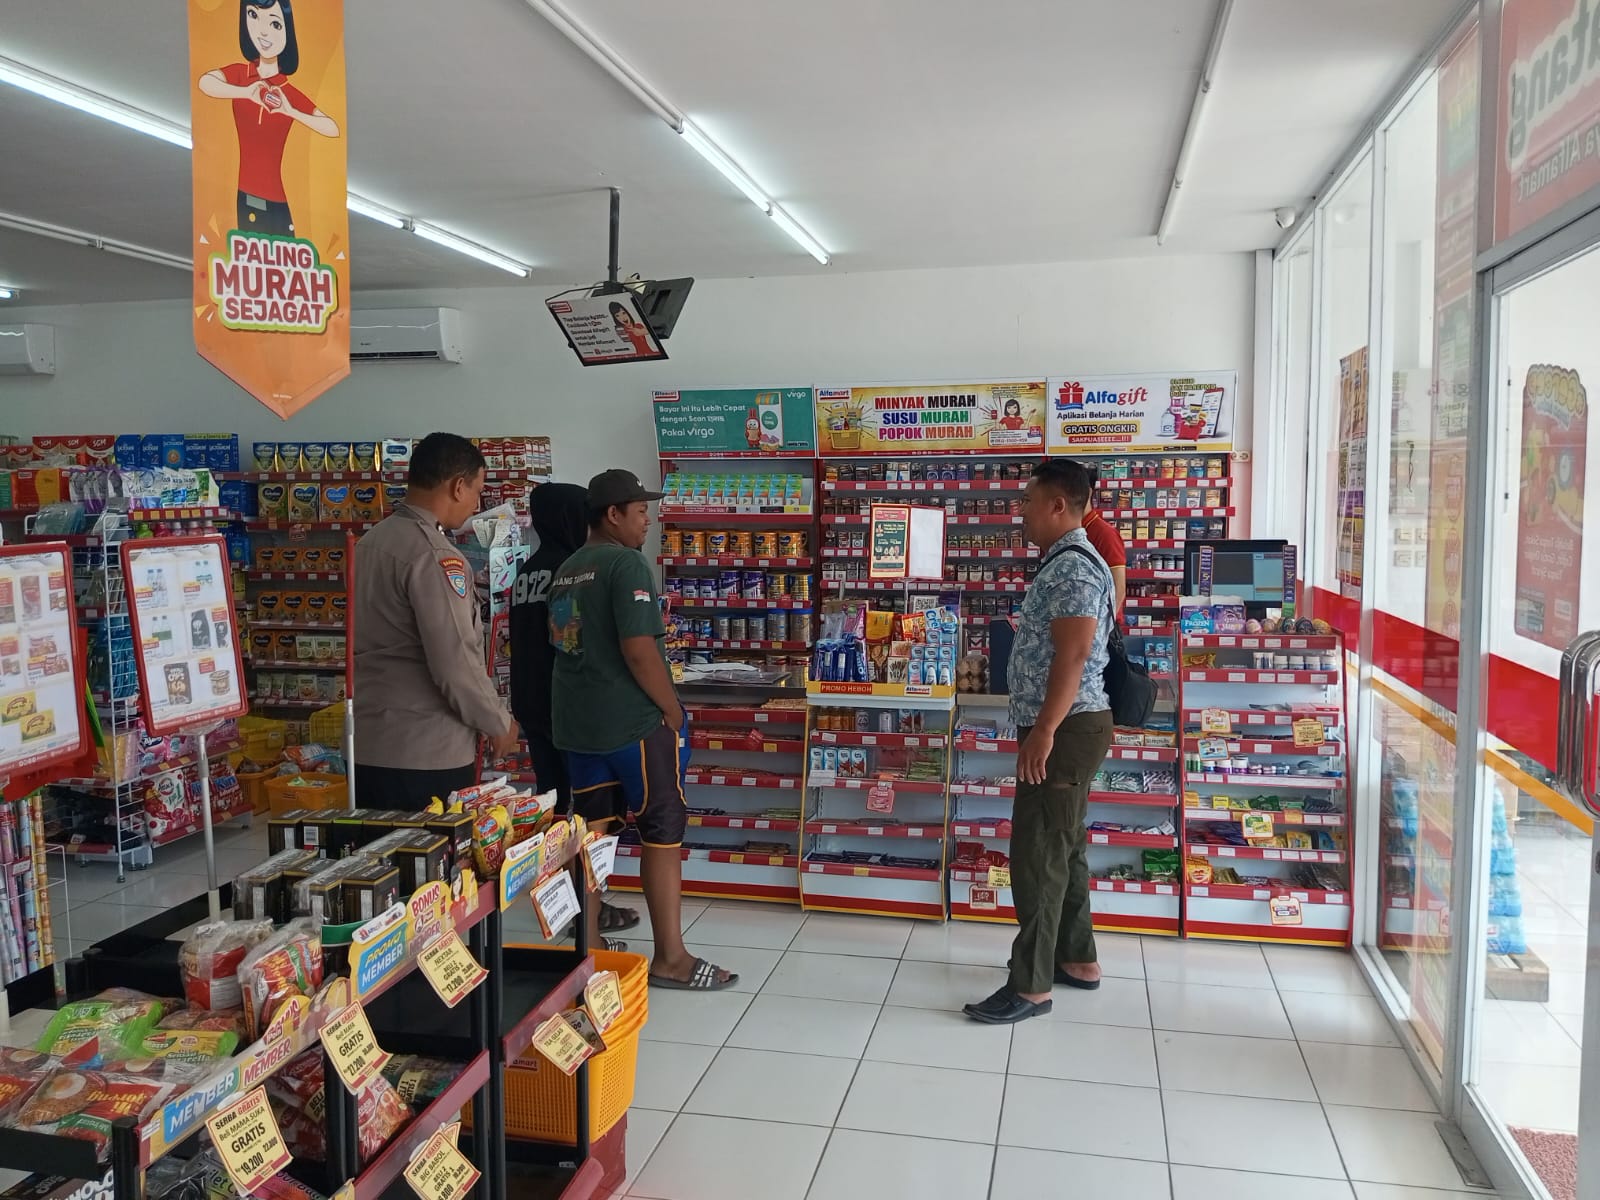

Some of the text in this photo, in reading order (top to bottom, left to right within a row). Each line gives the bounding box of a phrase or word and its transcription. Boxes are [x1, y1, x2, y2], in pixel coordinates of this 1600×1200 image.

[233, 239, 312, 269] PALING
[215, 262, 331, 303] MURAH
[225, 298, 324, 325] SEJAGAT
[702, 404, 721, 412] Lebih
[723, 404, 746, 413] Cepat
[874, 394, 976, 410] MINYAK MURAH
[1085, 387, 1148, 405] Alfagift
[660, 416, 687, 424] dengan
[882, 410, 969, 425] SUSU MURAH
[1057, 410, 1145, 420] Aplikasi Belanja Harian
[661, 428, 686, 437] Pakai
[879, 425, 973, 440] POPOK MURAH
[1064, 424, 1137, 434] GRATIS ONGKIR
[412, 884, 440, 917] BONUS
[365, 931, 402, 968] PROMO
[362, 943, 403, 987] MEMBER
[339, 1030, 364, 1056] GRATIS
[243, 1037, 292, 1088] MEMBER
[170, 1071, 235, 1133] MEMBER
[215, 1111, 237, 1130] SERBA
[219, 1106, 265, 1141] Beli MAMA SUKA
[231, 1122, 266, 1153] GRATIS
[411, 1158, 427, 1177] SERBA
[420, 1150, 446, 1181] BIG BABOL
